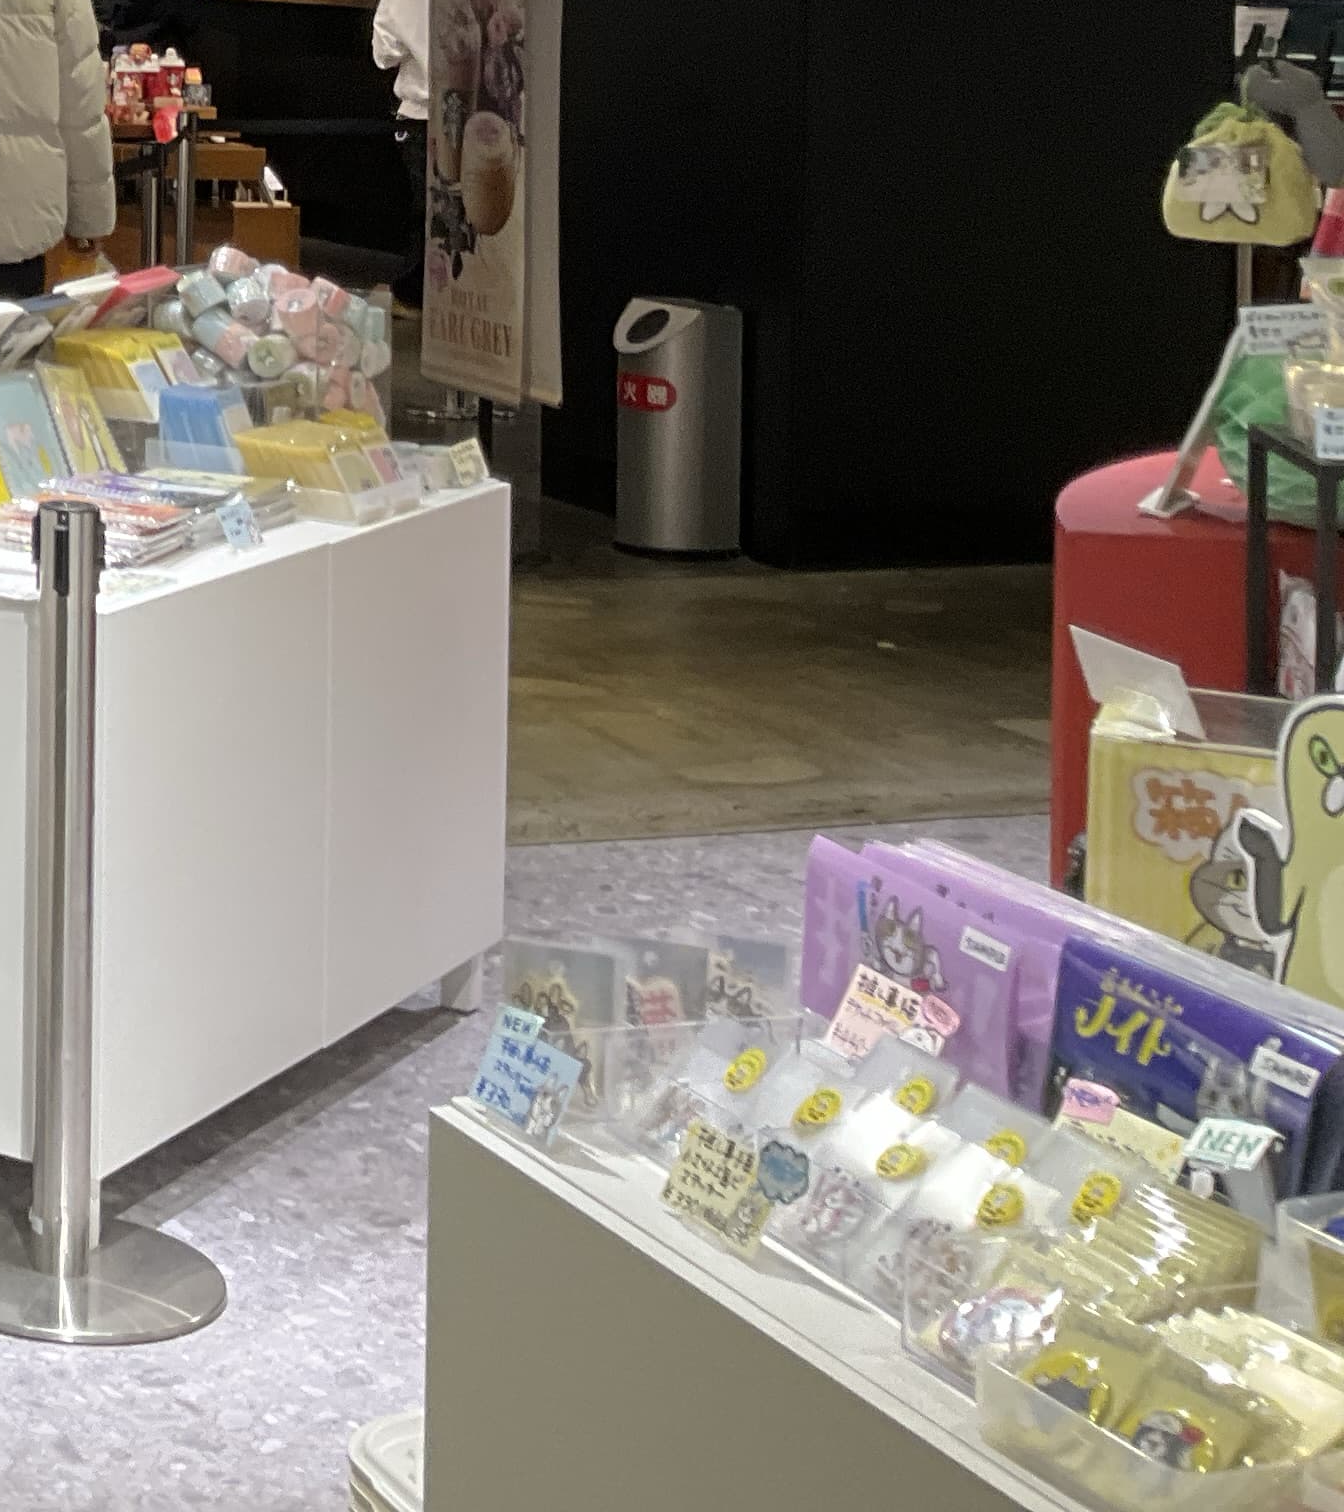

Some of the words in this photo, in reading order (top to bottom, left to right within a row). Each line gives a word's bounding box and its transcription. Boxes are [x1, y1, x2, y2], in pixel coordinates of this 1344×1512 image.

[471, 318, 512, 357] GREY
[502, 1013, 532, 1034] NEW
[1199, 1127, 1263, 1157] NEW
